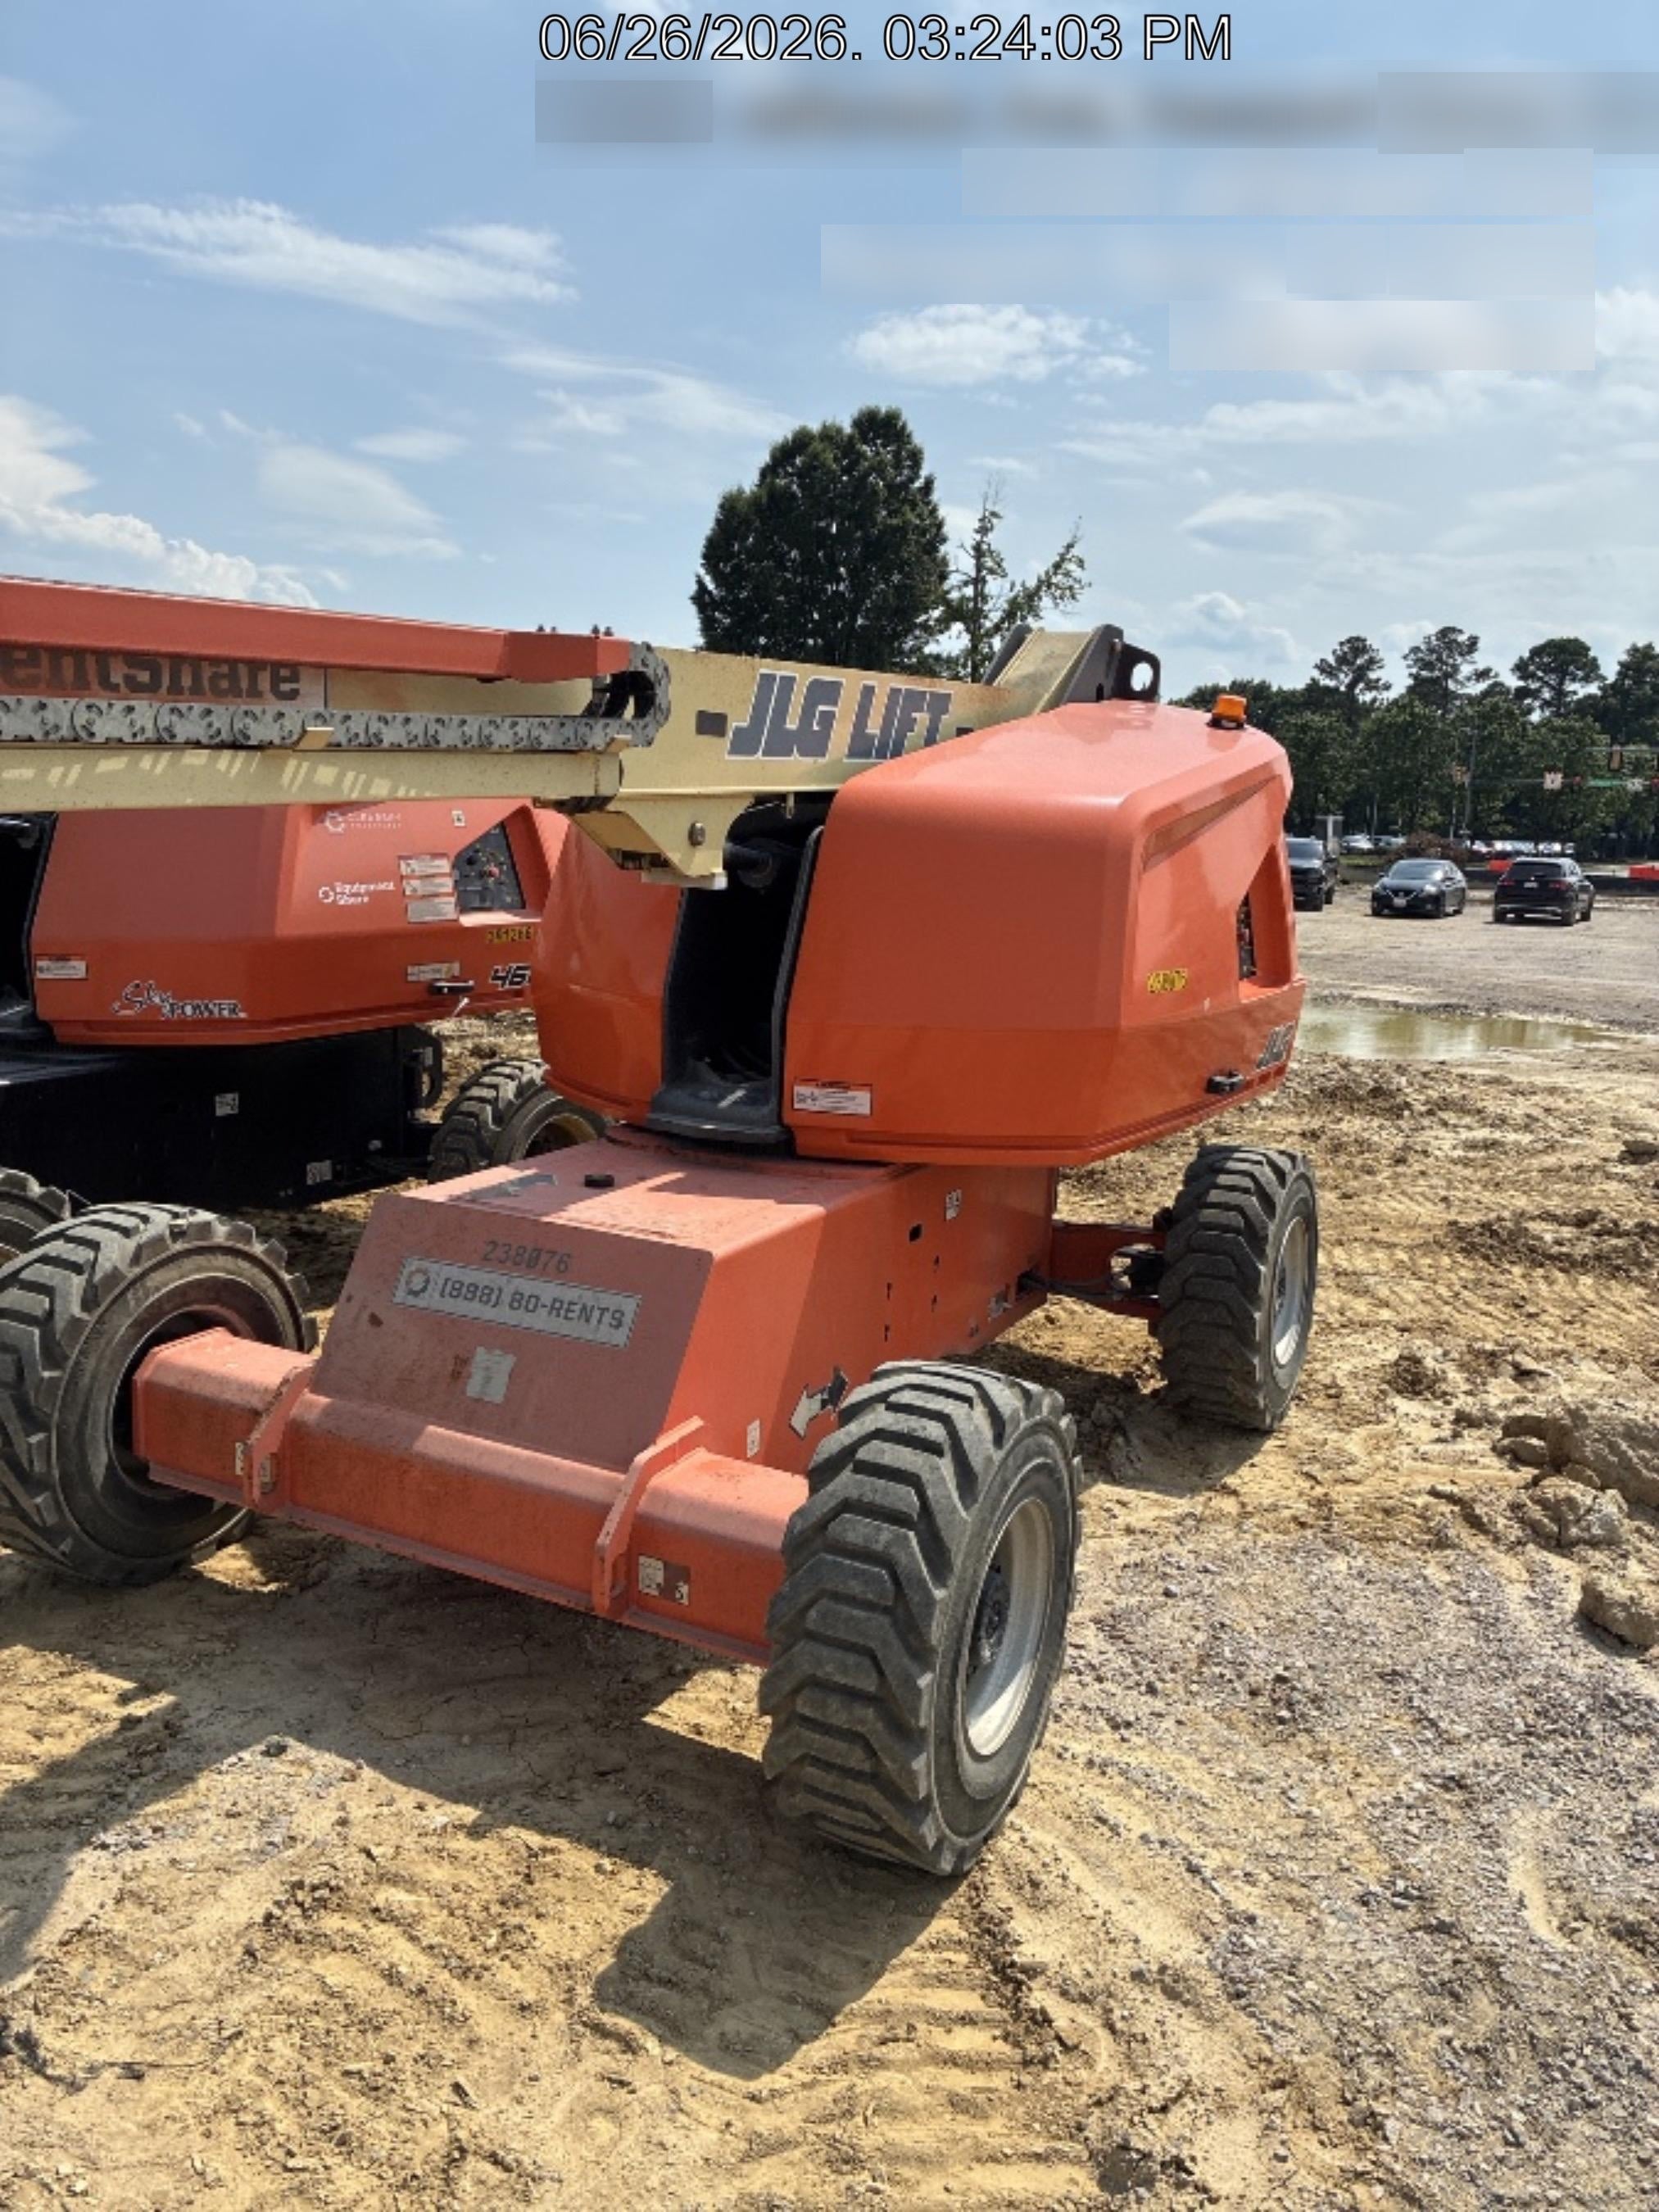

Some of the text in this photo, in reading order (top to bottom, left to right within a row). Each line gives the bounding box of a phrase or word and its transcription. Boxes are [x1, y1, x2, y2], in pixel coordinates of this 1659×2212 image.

[725, 669, 954, 762] JLG LIFT
[482, 1240, 572, 1273] 238076
